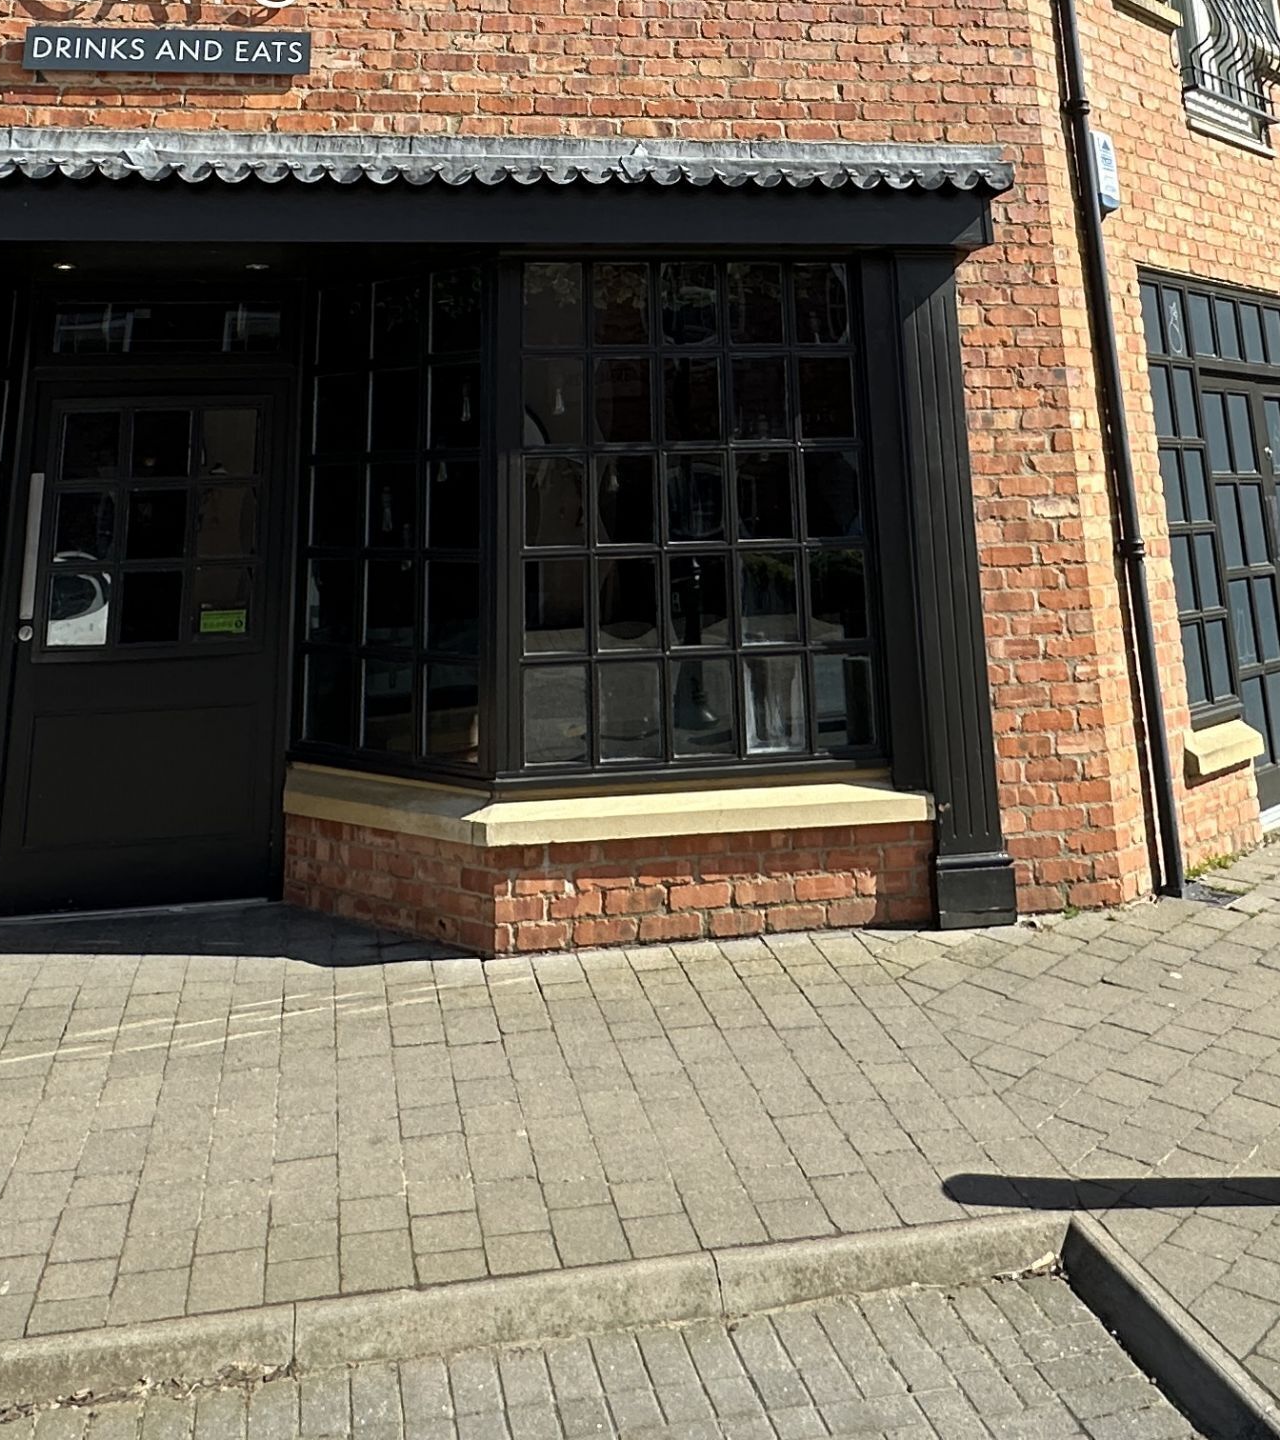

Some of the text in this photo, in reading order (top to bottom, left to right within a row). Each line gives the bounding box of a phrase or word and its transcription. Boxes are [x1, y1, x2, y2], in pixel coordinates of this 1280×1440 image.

[32, 36, 303, 63] DRINKS AND EATS
